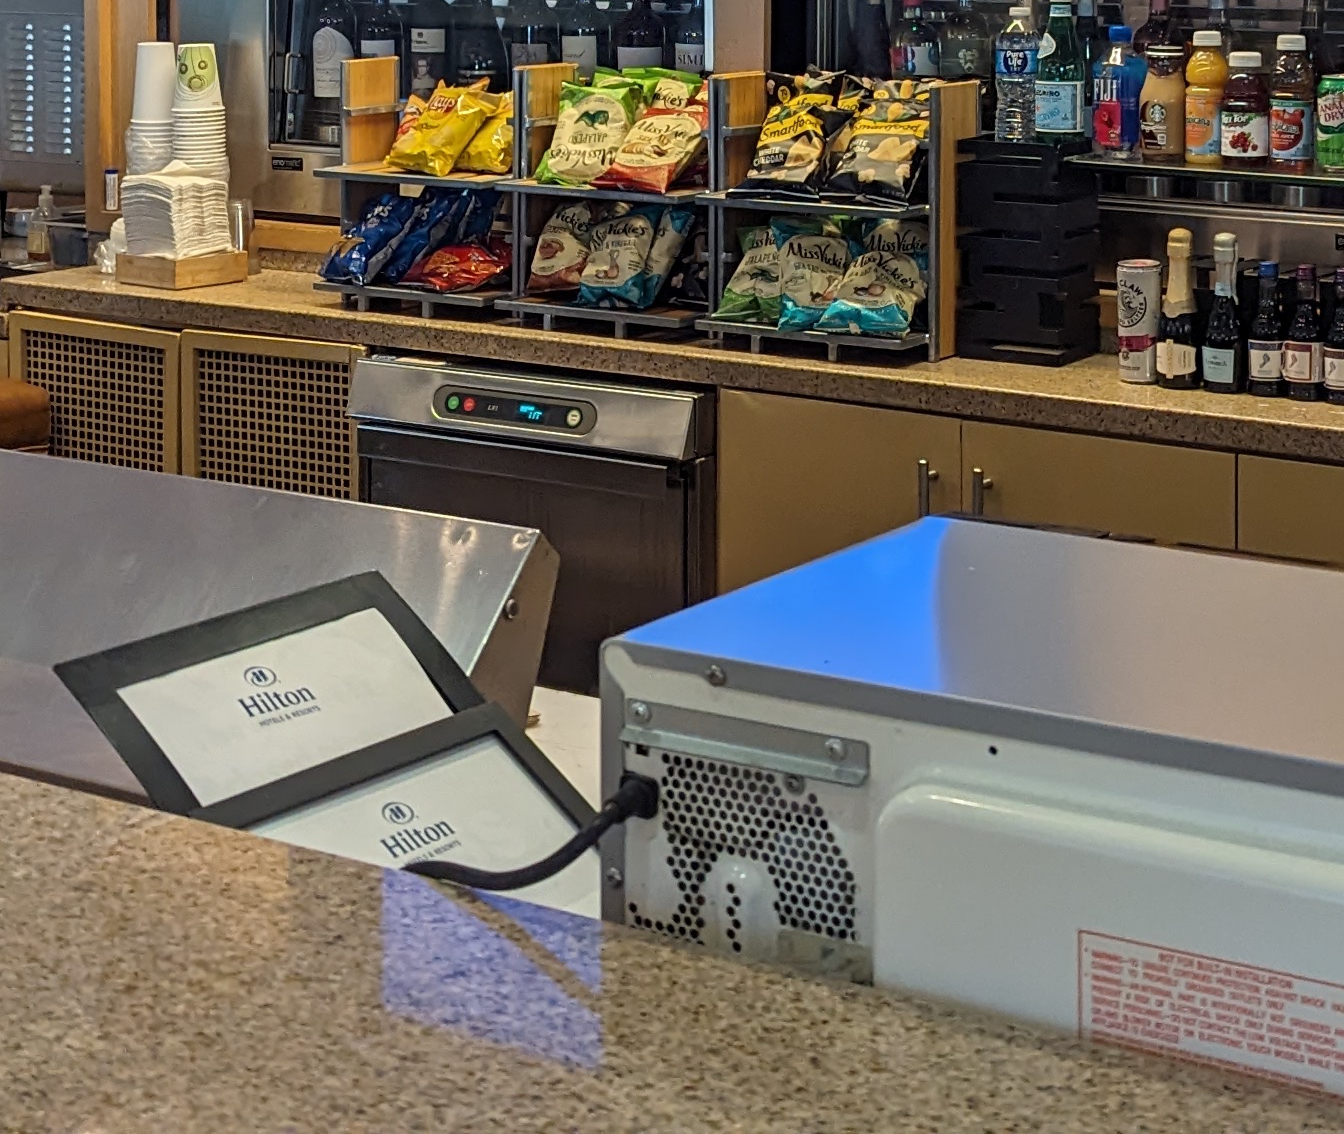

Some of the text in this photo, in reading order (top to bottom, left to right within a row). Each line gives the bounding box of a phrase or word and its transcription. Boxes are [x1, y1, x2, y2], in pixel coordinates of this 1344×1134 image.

[1006, 50, 1025, 59] Pure
[1093, 78, 1117, 102] FIJI
[1324, 110, 1344, 123] DRY
[1118, 279, 1144, 297] CLAW
[237, 686, 317, 718] Hilton
[379, 820, 456, 859] Hilton
